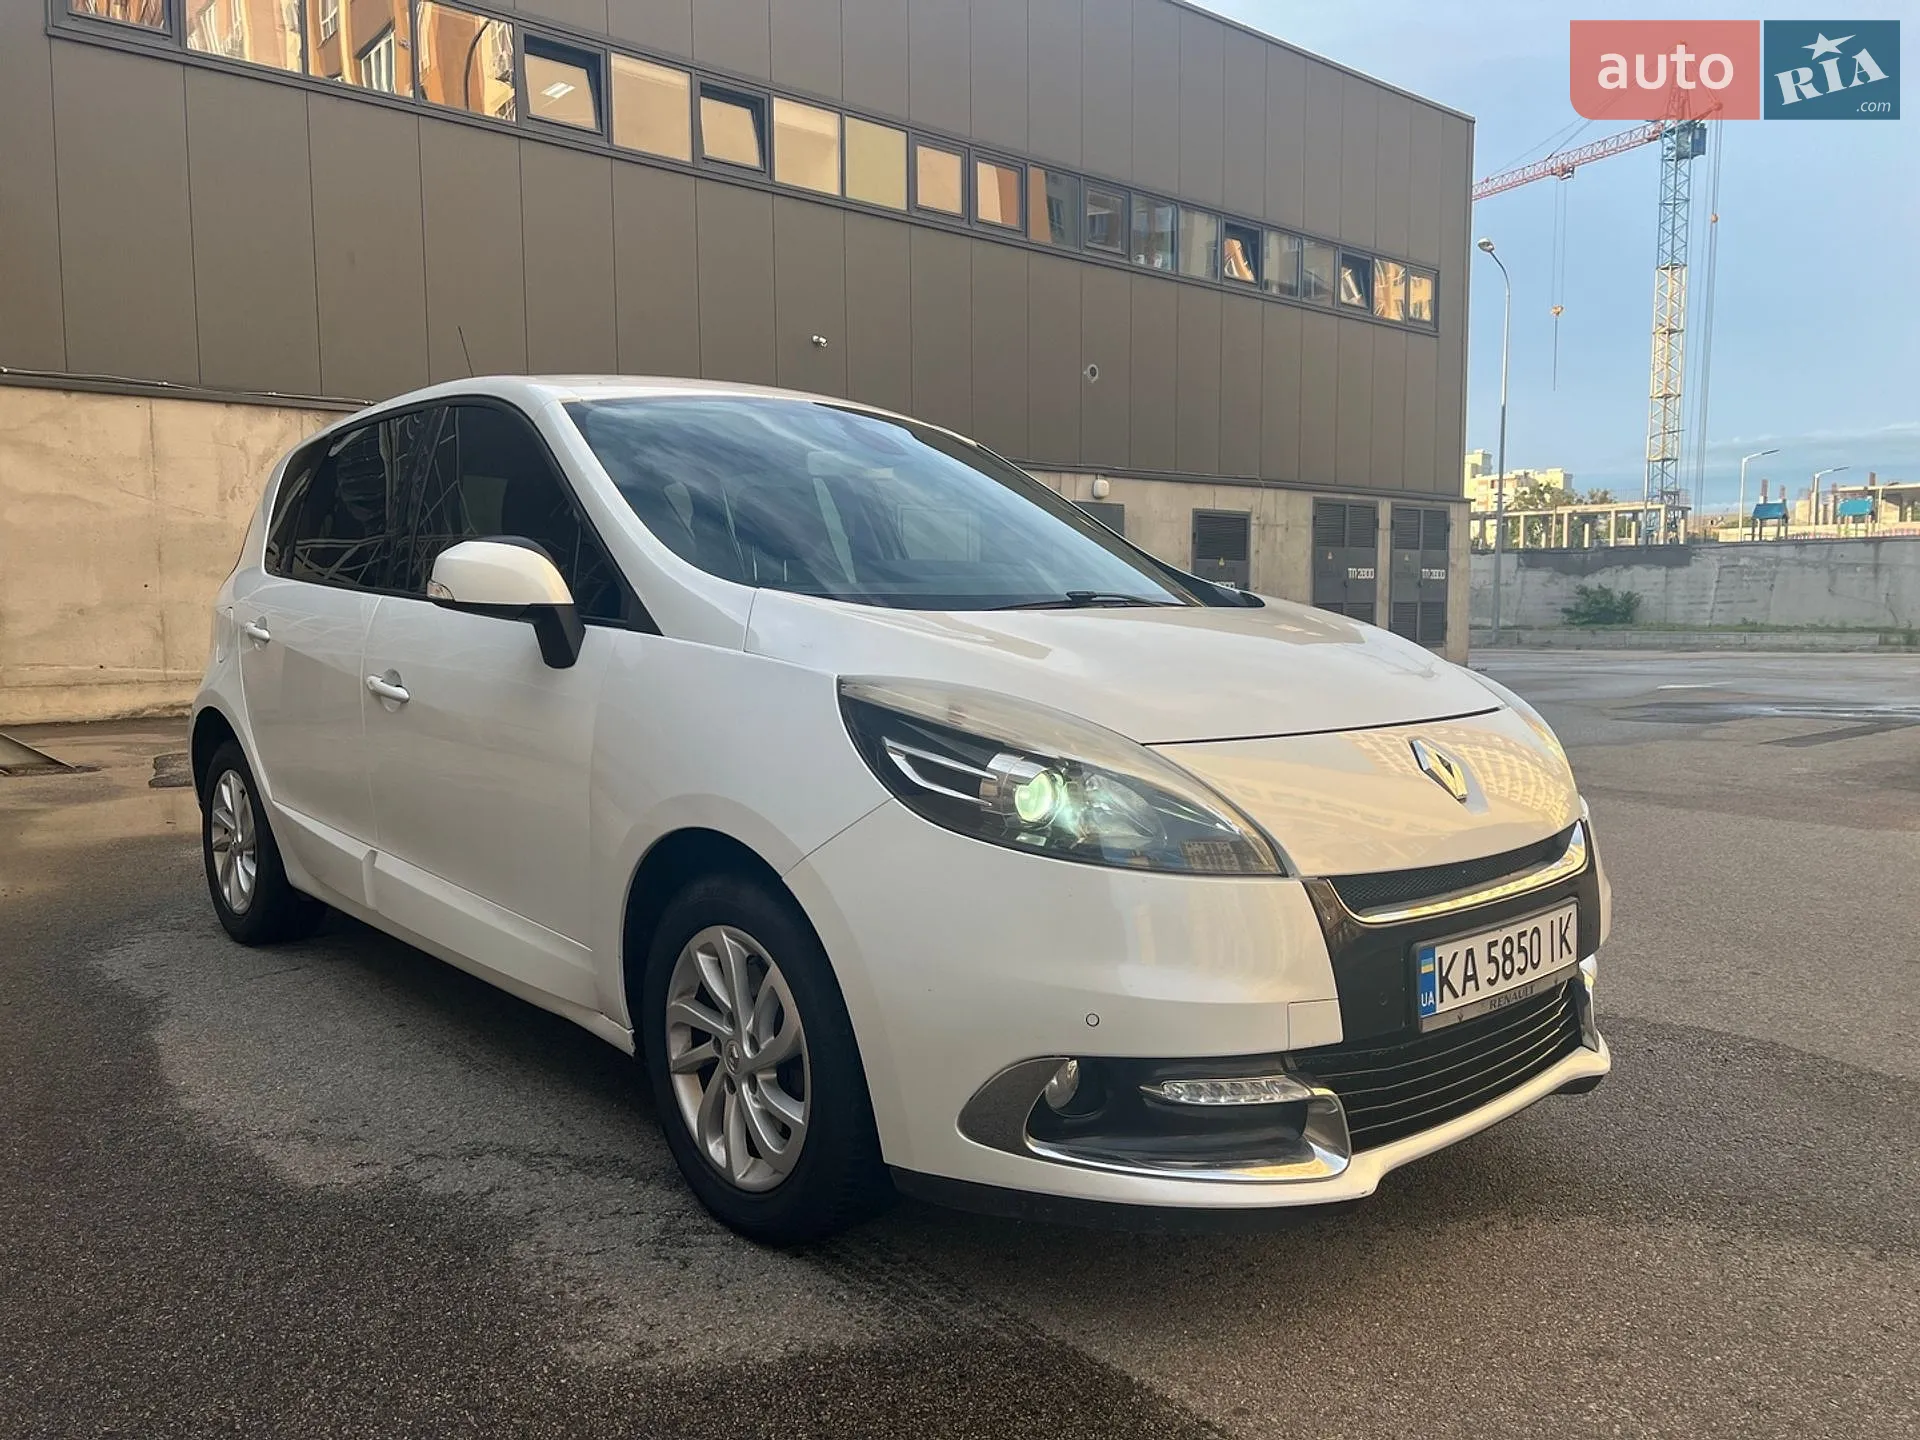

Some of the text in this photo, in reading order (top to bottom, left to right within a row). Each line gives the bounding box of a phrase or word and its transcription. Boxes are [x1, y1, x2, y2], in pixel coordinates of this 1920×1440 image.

[1438, 912, 1573, 1003] KA 5850 IK
[1421, 991, 1435, 1007] UA
[1489, 985, 1535, 1010] RENAULT
